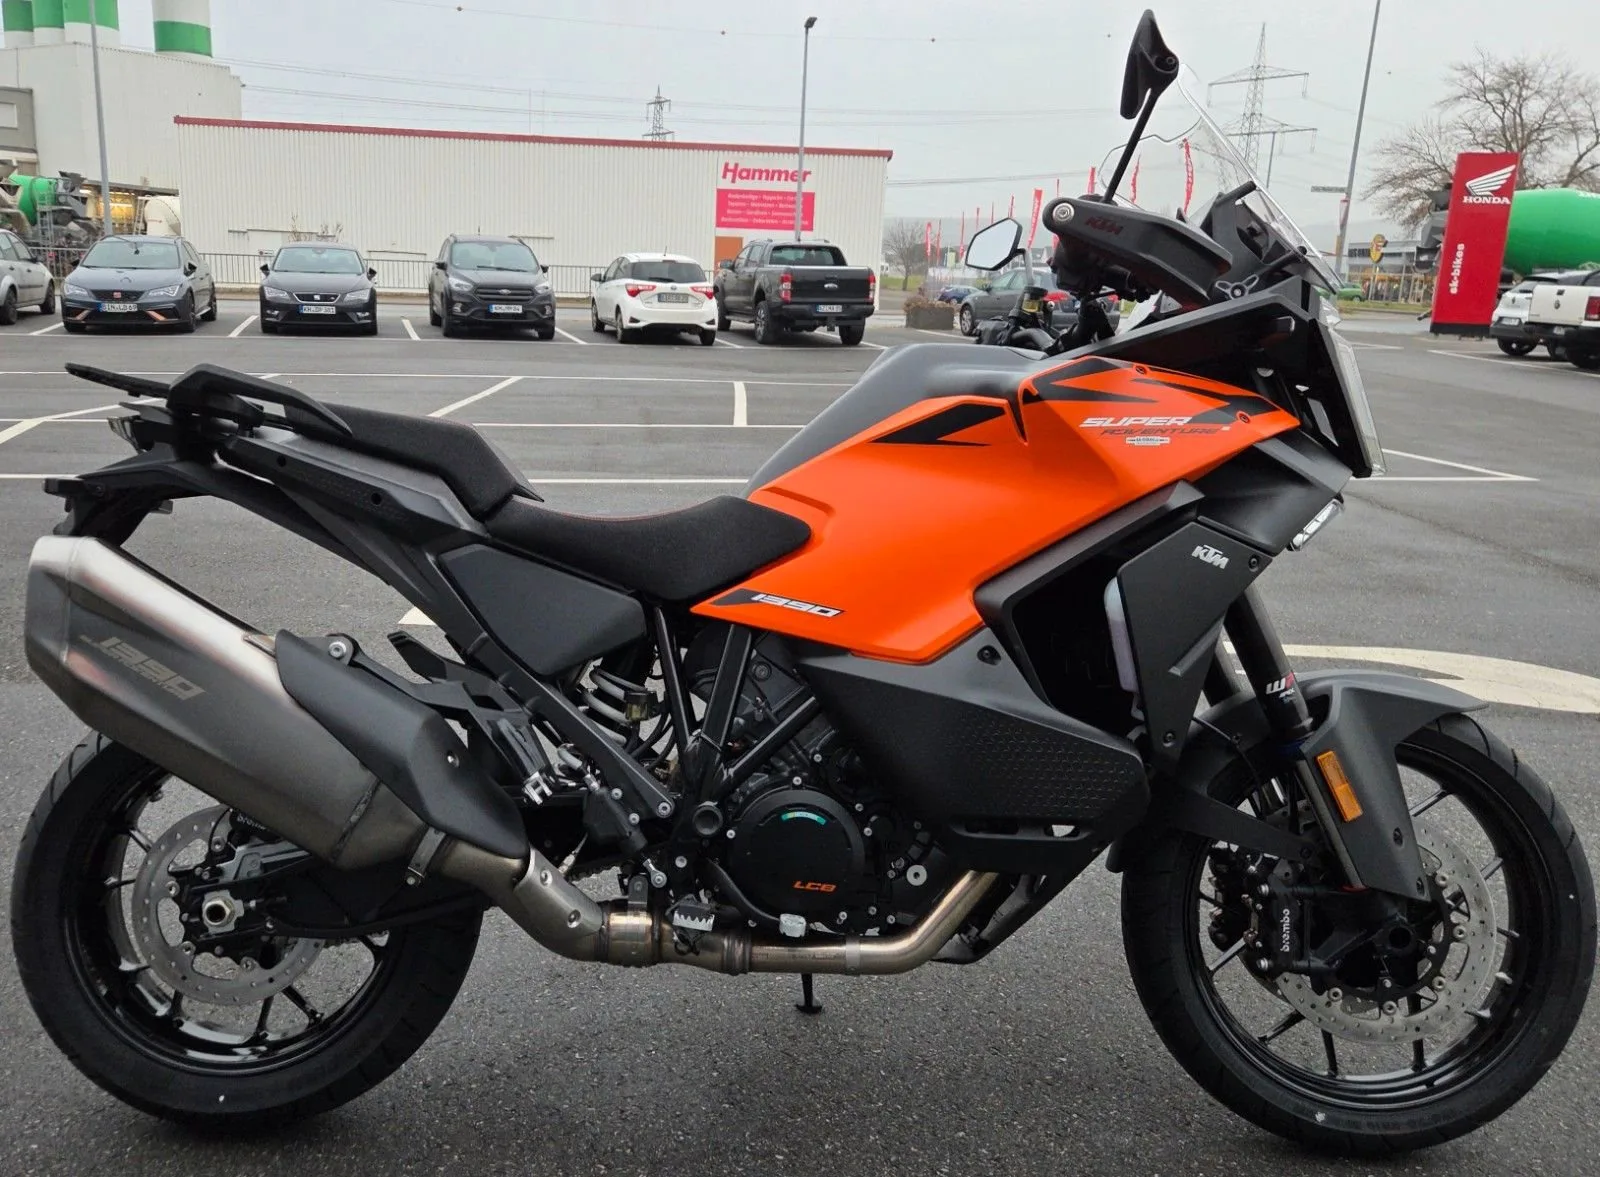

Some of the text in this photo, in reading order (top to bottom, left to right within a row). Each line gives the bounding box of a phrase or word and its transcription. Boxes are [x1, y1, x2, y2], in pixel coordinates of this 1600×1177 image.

[722, 162, 812, 184] Hammer
[1462, 195, 1511, 205] HONDA
[1085, 216, 1124, 235] KTM
[1079, 416, 1193, 428] SUPER
[1100, 427, 1221, 436] ADVENTURE
[1191, 544, 1229, 570] KTM
[793, 880, 837, 893] LC8
[1280, 908, 1291, 952] brembo
